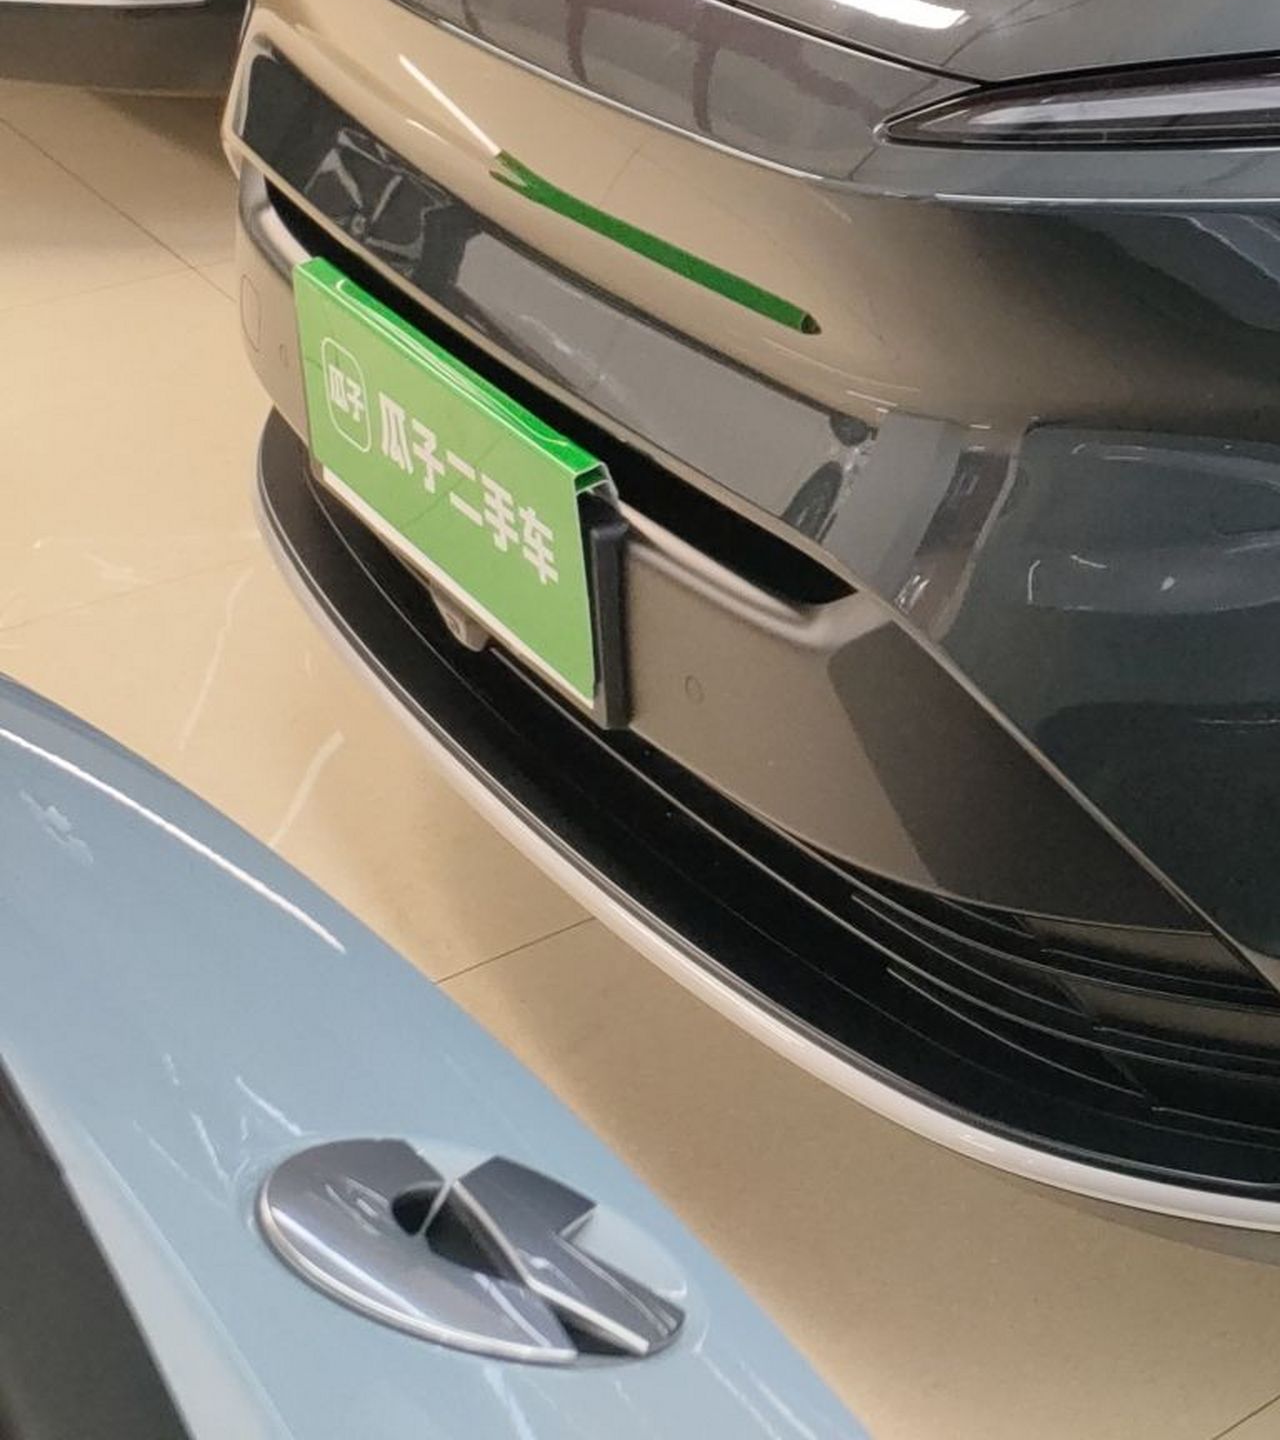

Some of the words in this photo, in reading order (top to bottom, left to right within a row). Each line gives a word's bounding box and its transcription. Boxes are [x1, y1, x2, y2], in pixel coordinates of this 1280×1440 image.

[329, 365, 364, 422] 瓜子
[379, 391, 559, 584] 瓜子二手车
